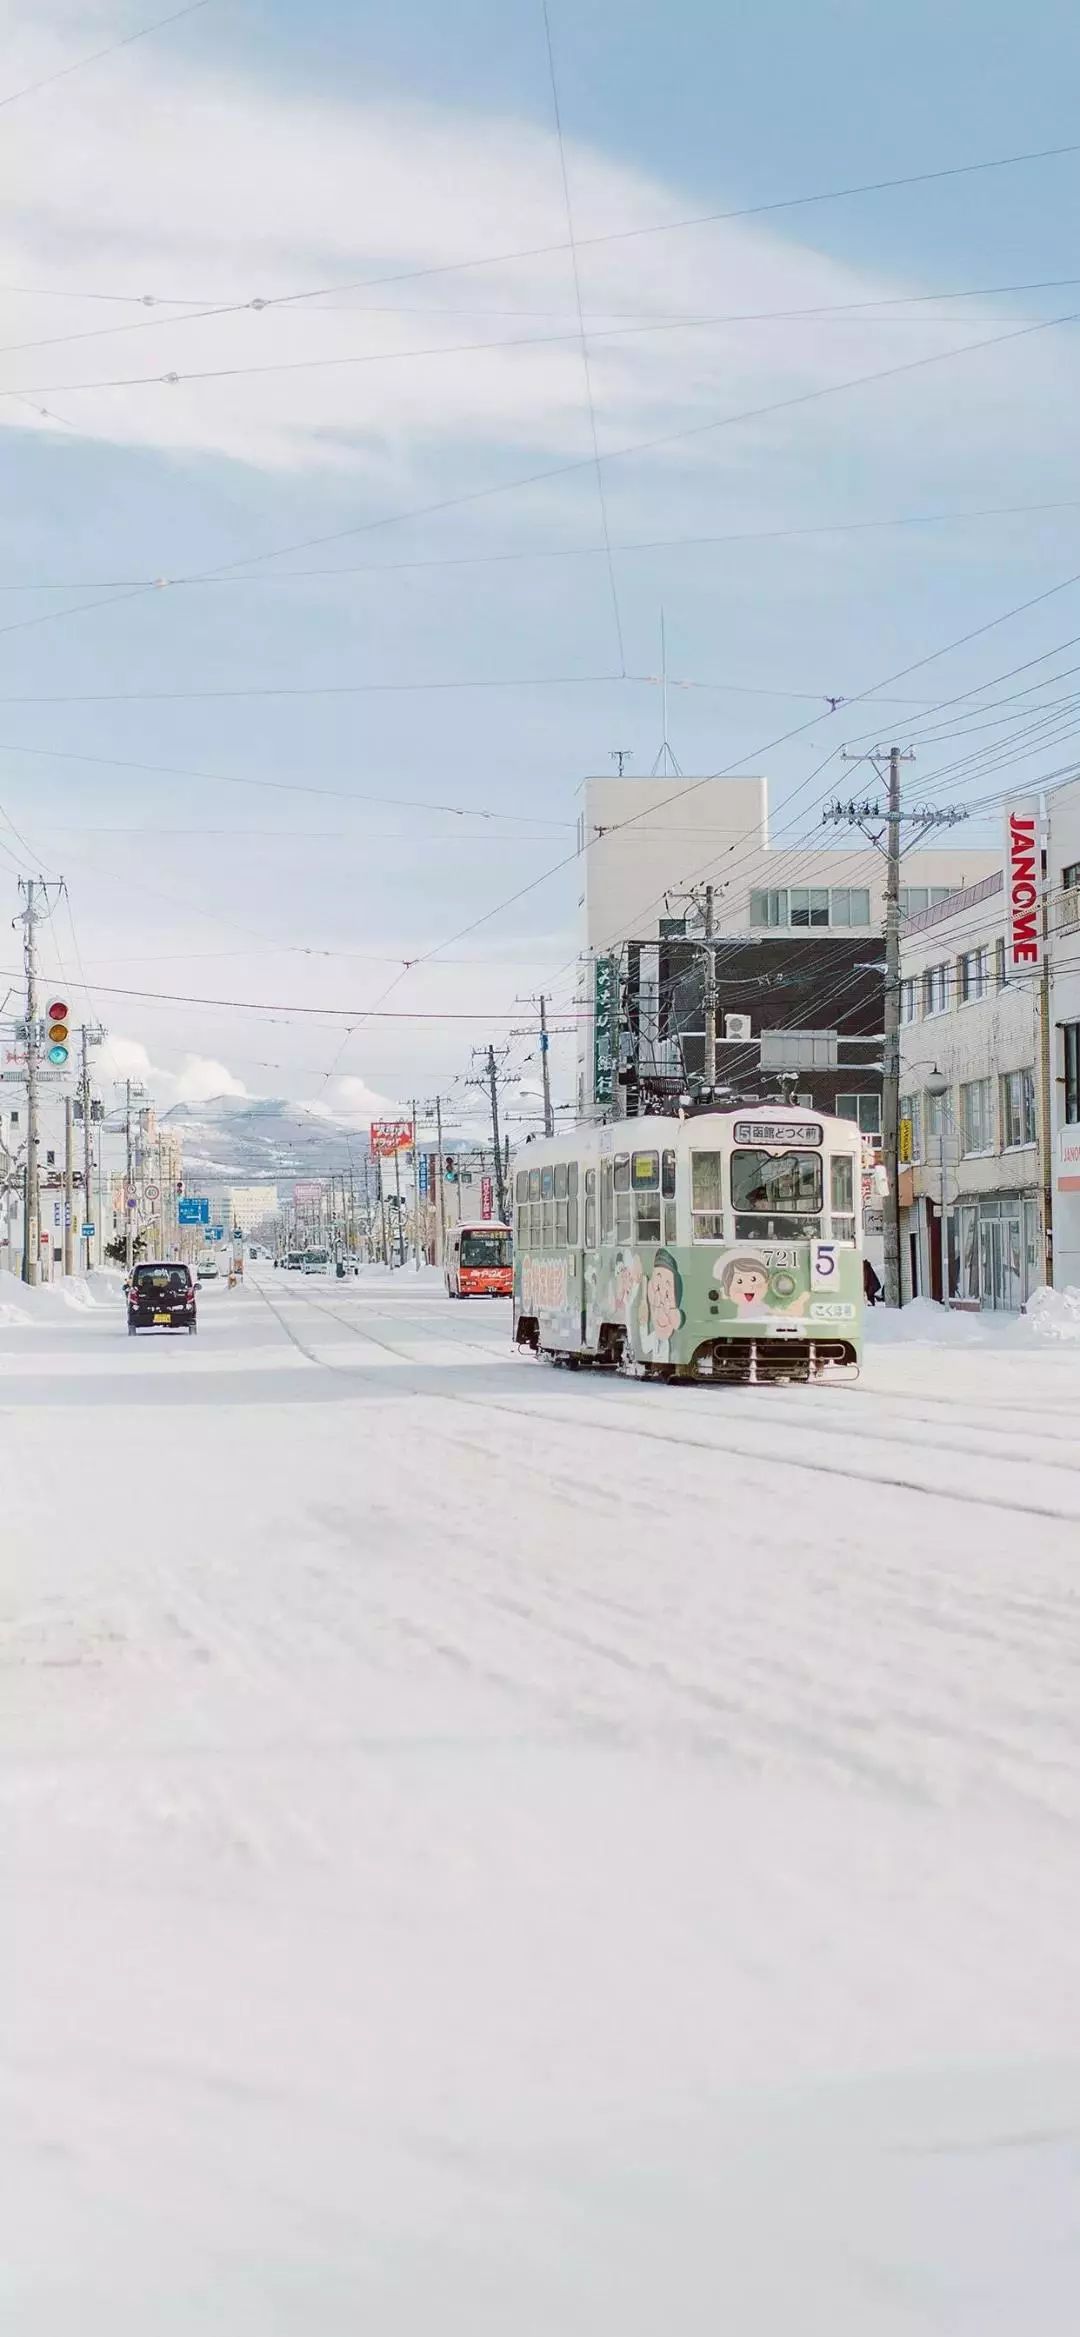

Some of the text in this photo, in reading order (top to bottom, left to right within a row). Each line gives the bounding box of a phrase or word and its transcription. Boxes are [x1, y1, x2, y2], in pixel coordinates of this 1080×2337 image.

[1010, 812, 1037, 963] JANOME
[752, 1126, 817, 1140] 函館どつく前
[763, 1250, 797, 1267] 721
[816, 1246, 835, 1276] 5
